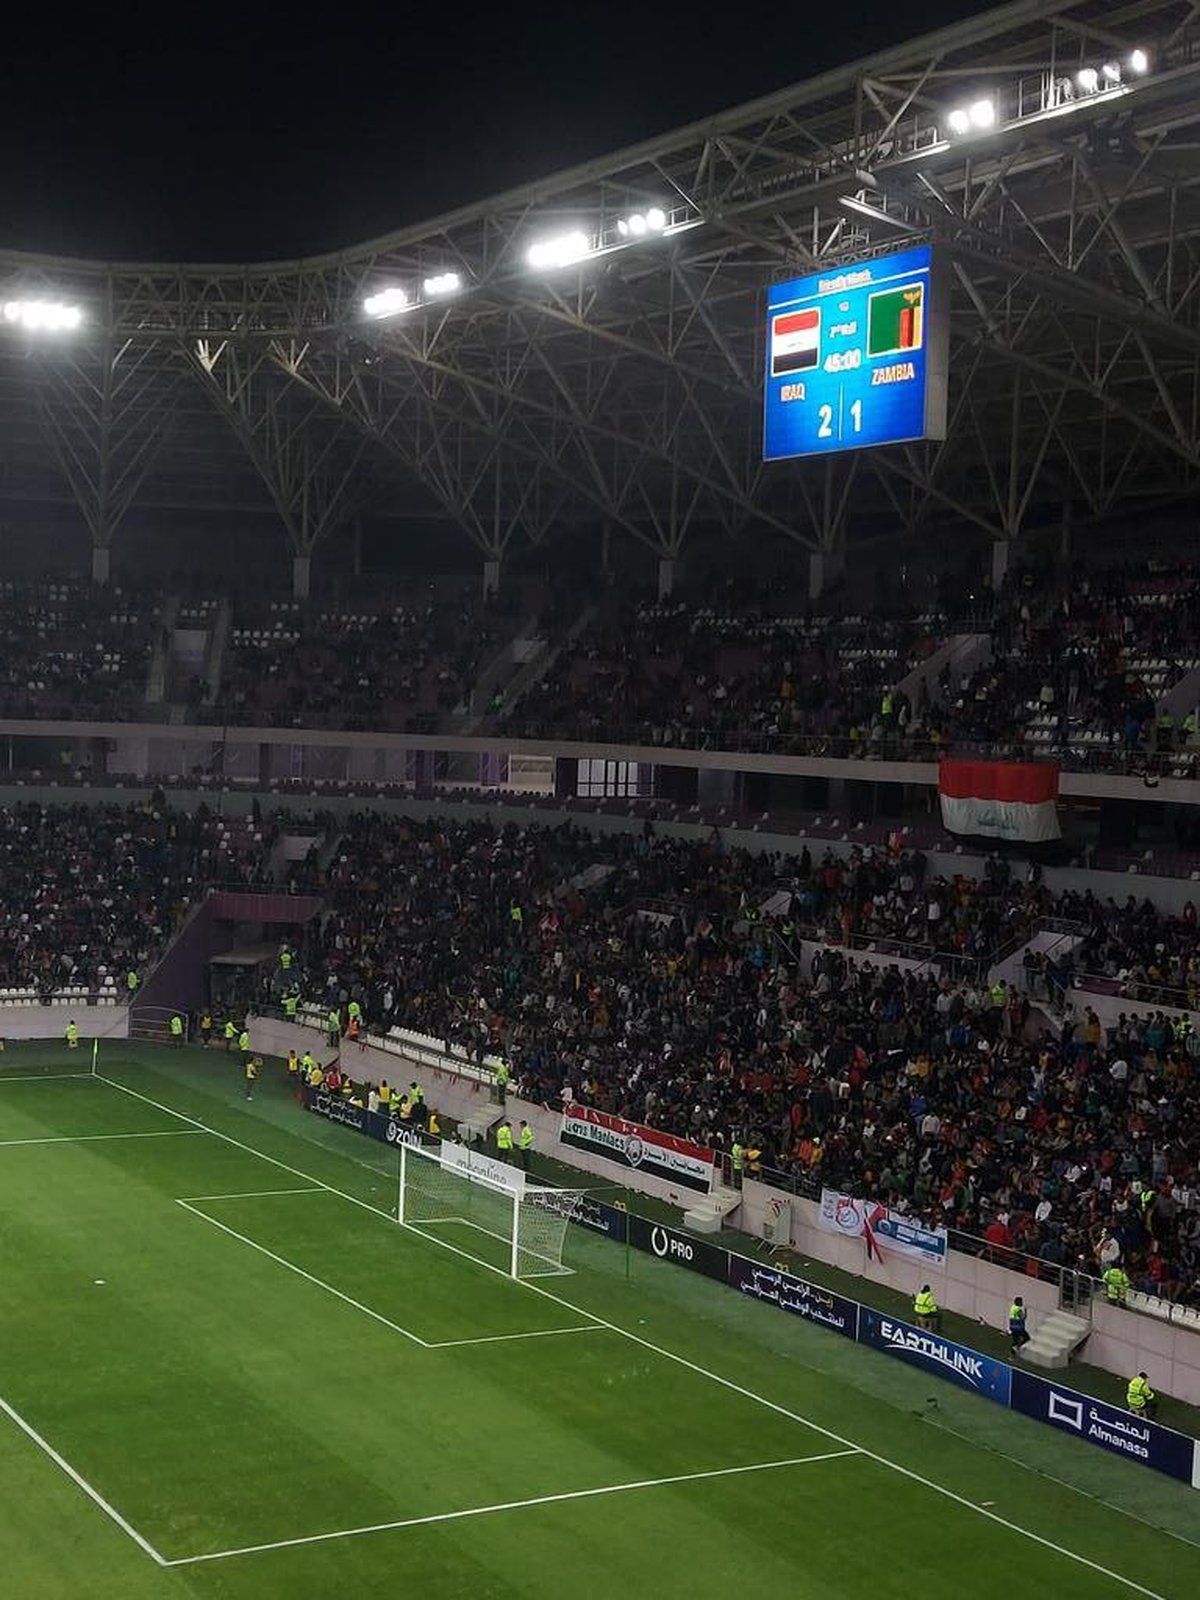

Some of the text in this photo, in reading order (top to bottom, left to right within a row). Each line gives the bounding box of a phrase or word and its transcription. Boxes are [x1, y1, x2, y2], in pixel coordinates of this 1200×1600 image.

[824, 348, 861, 373] 45:00
[871, 363, 915, 386] ZAMBIA
[780, 383, 806, 402] IRAQ
[818, 399, 862, 438] 2 1
[590, 1124, 625, 1151] Maniacs
[670, 1238, 694, 1261] PRO
[880, 1320, 984, 1379] EARTHLINK
[1089, 1406, 1150, 1443] المنصة
[1088, 1423, 1149, 1458] Almanasa
